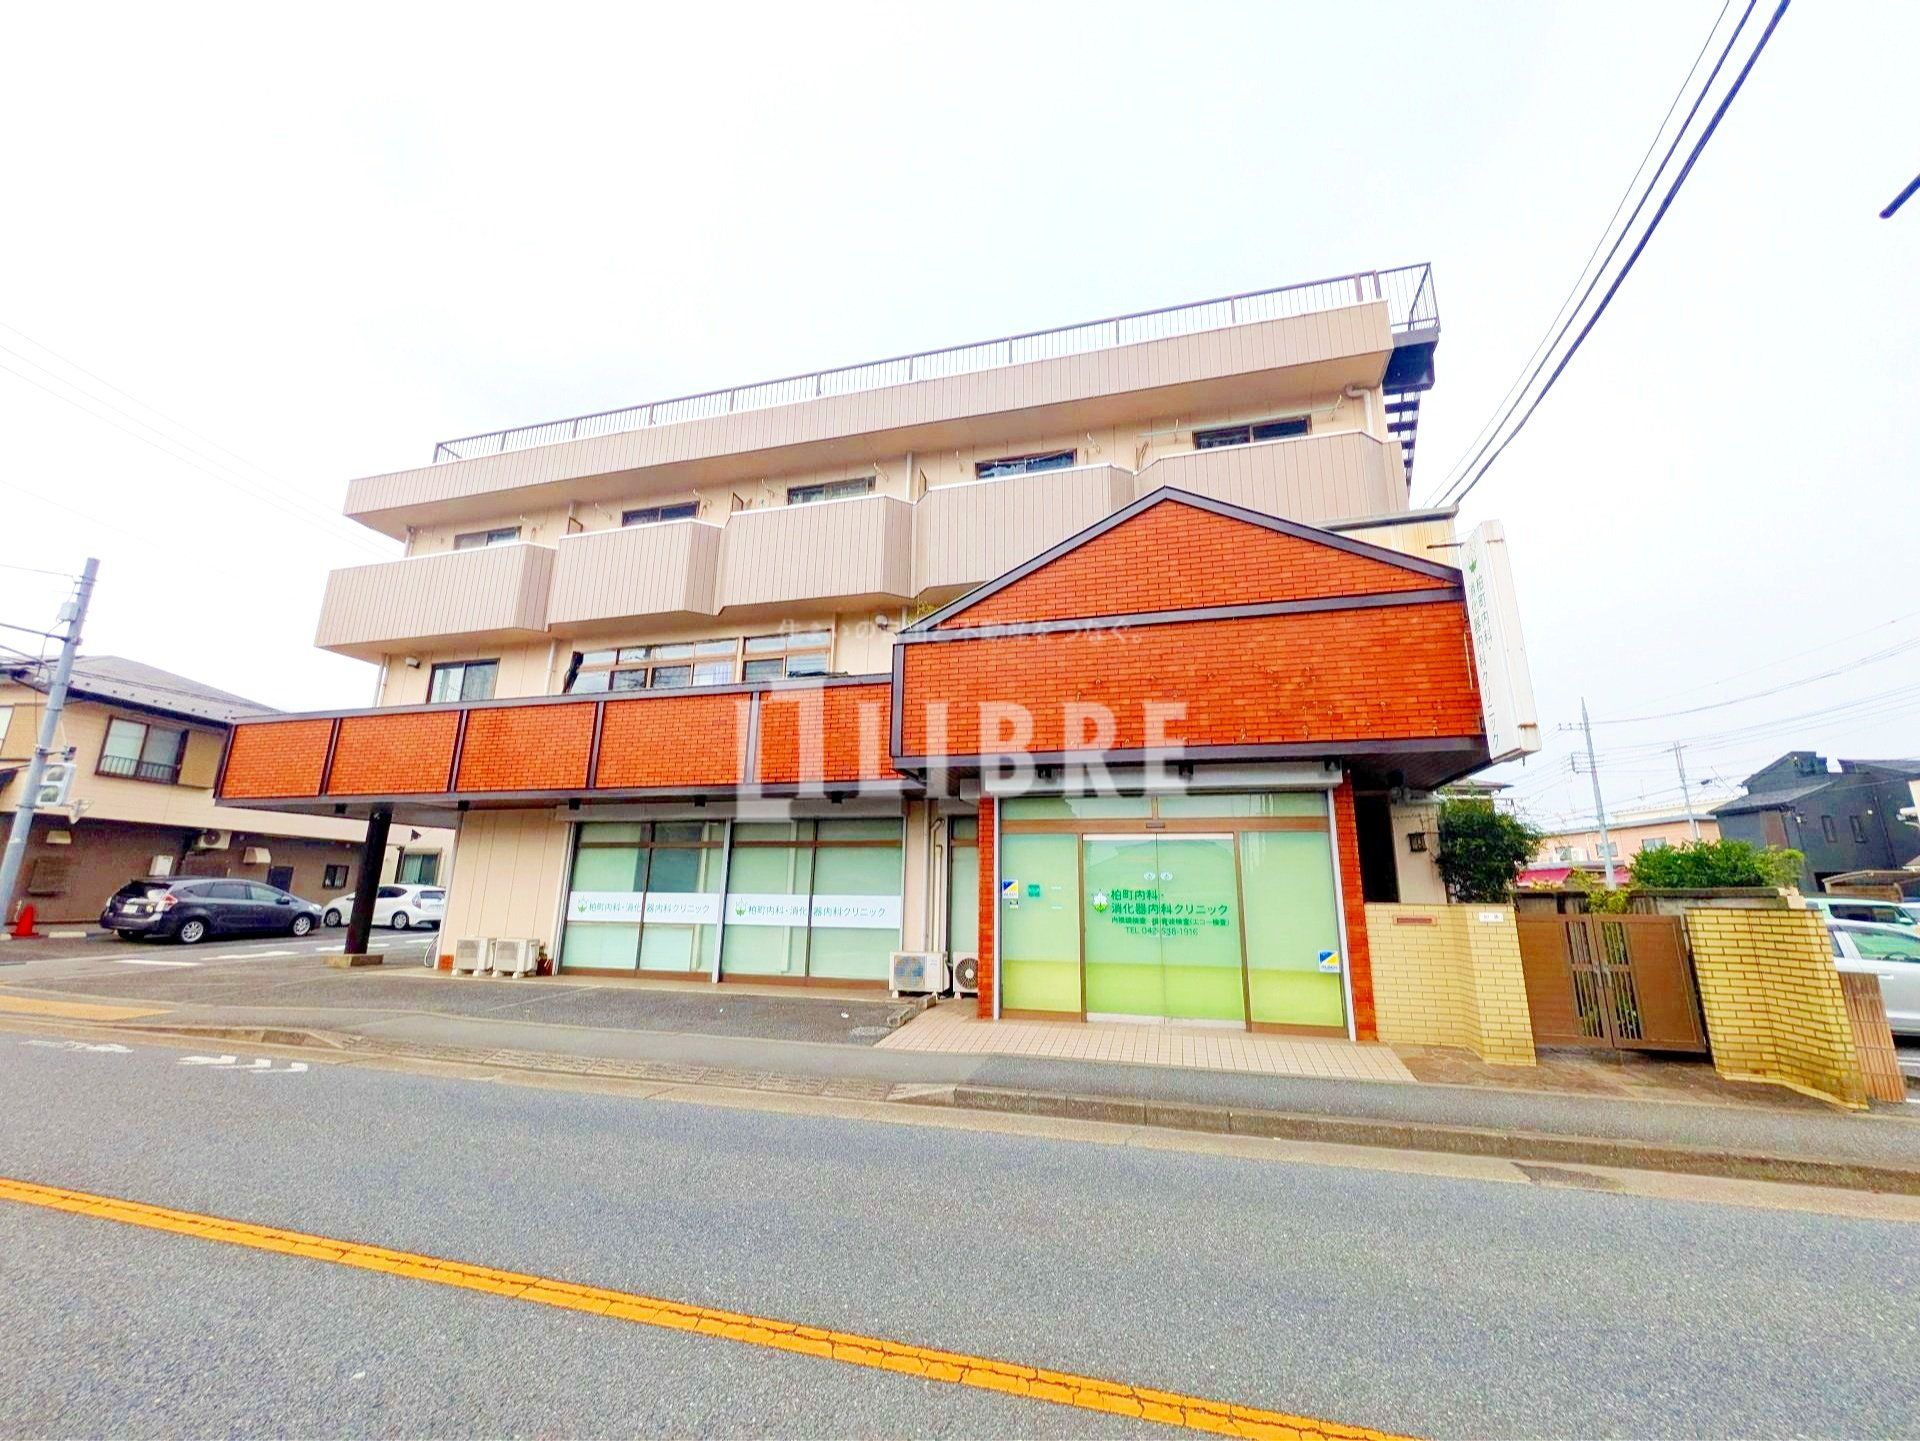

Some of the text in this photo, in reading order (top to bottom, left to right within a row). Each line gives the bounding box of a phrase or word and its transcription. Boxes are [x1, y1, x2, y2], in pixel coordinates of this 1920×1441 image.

[1111, 903, 1228, 915] 消化器内科クリニック
